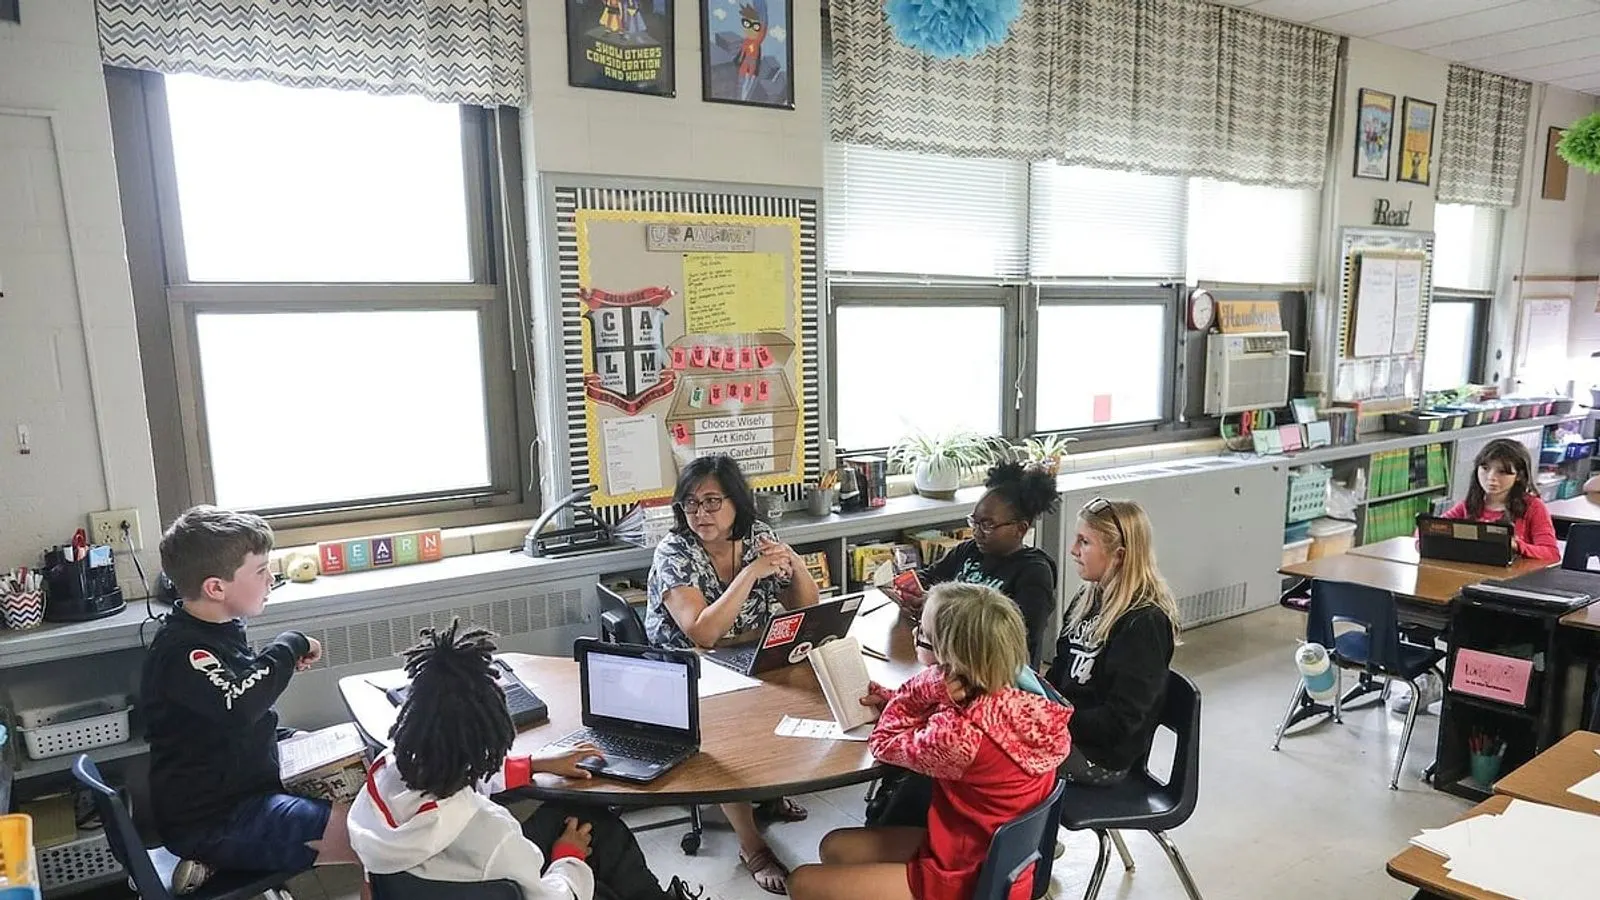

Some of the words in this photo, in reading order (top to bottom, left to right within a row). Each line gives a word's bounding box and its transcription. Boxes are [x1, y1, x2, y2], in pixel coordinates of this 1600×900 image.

[595, 41, 623, 59] SHOW
[624, 47, 662, 60] OTHERS
[586, 49, 661, 71] CONSIDERATION
[604, 66, 624, 80] AND
[625, 70, 656, 82] HONOR
[702, 419, 736, 430] Choose
[737, 416, 766, 426] Wisely
[712, 434, 728, 443] Act
[730, 431, 756, 442] Kindly
[730, 445, 768, 458] Carefully
[327, 535, 436, 560] LEARN
